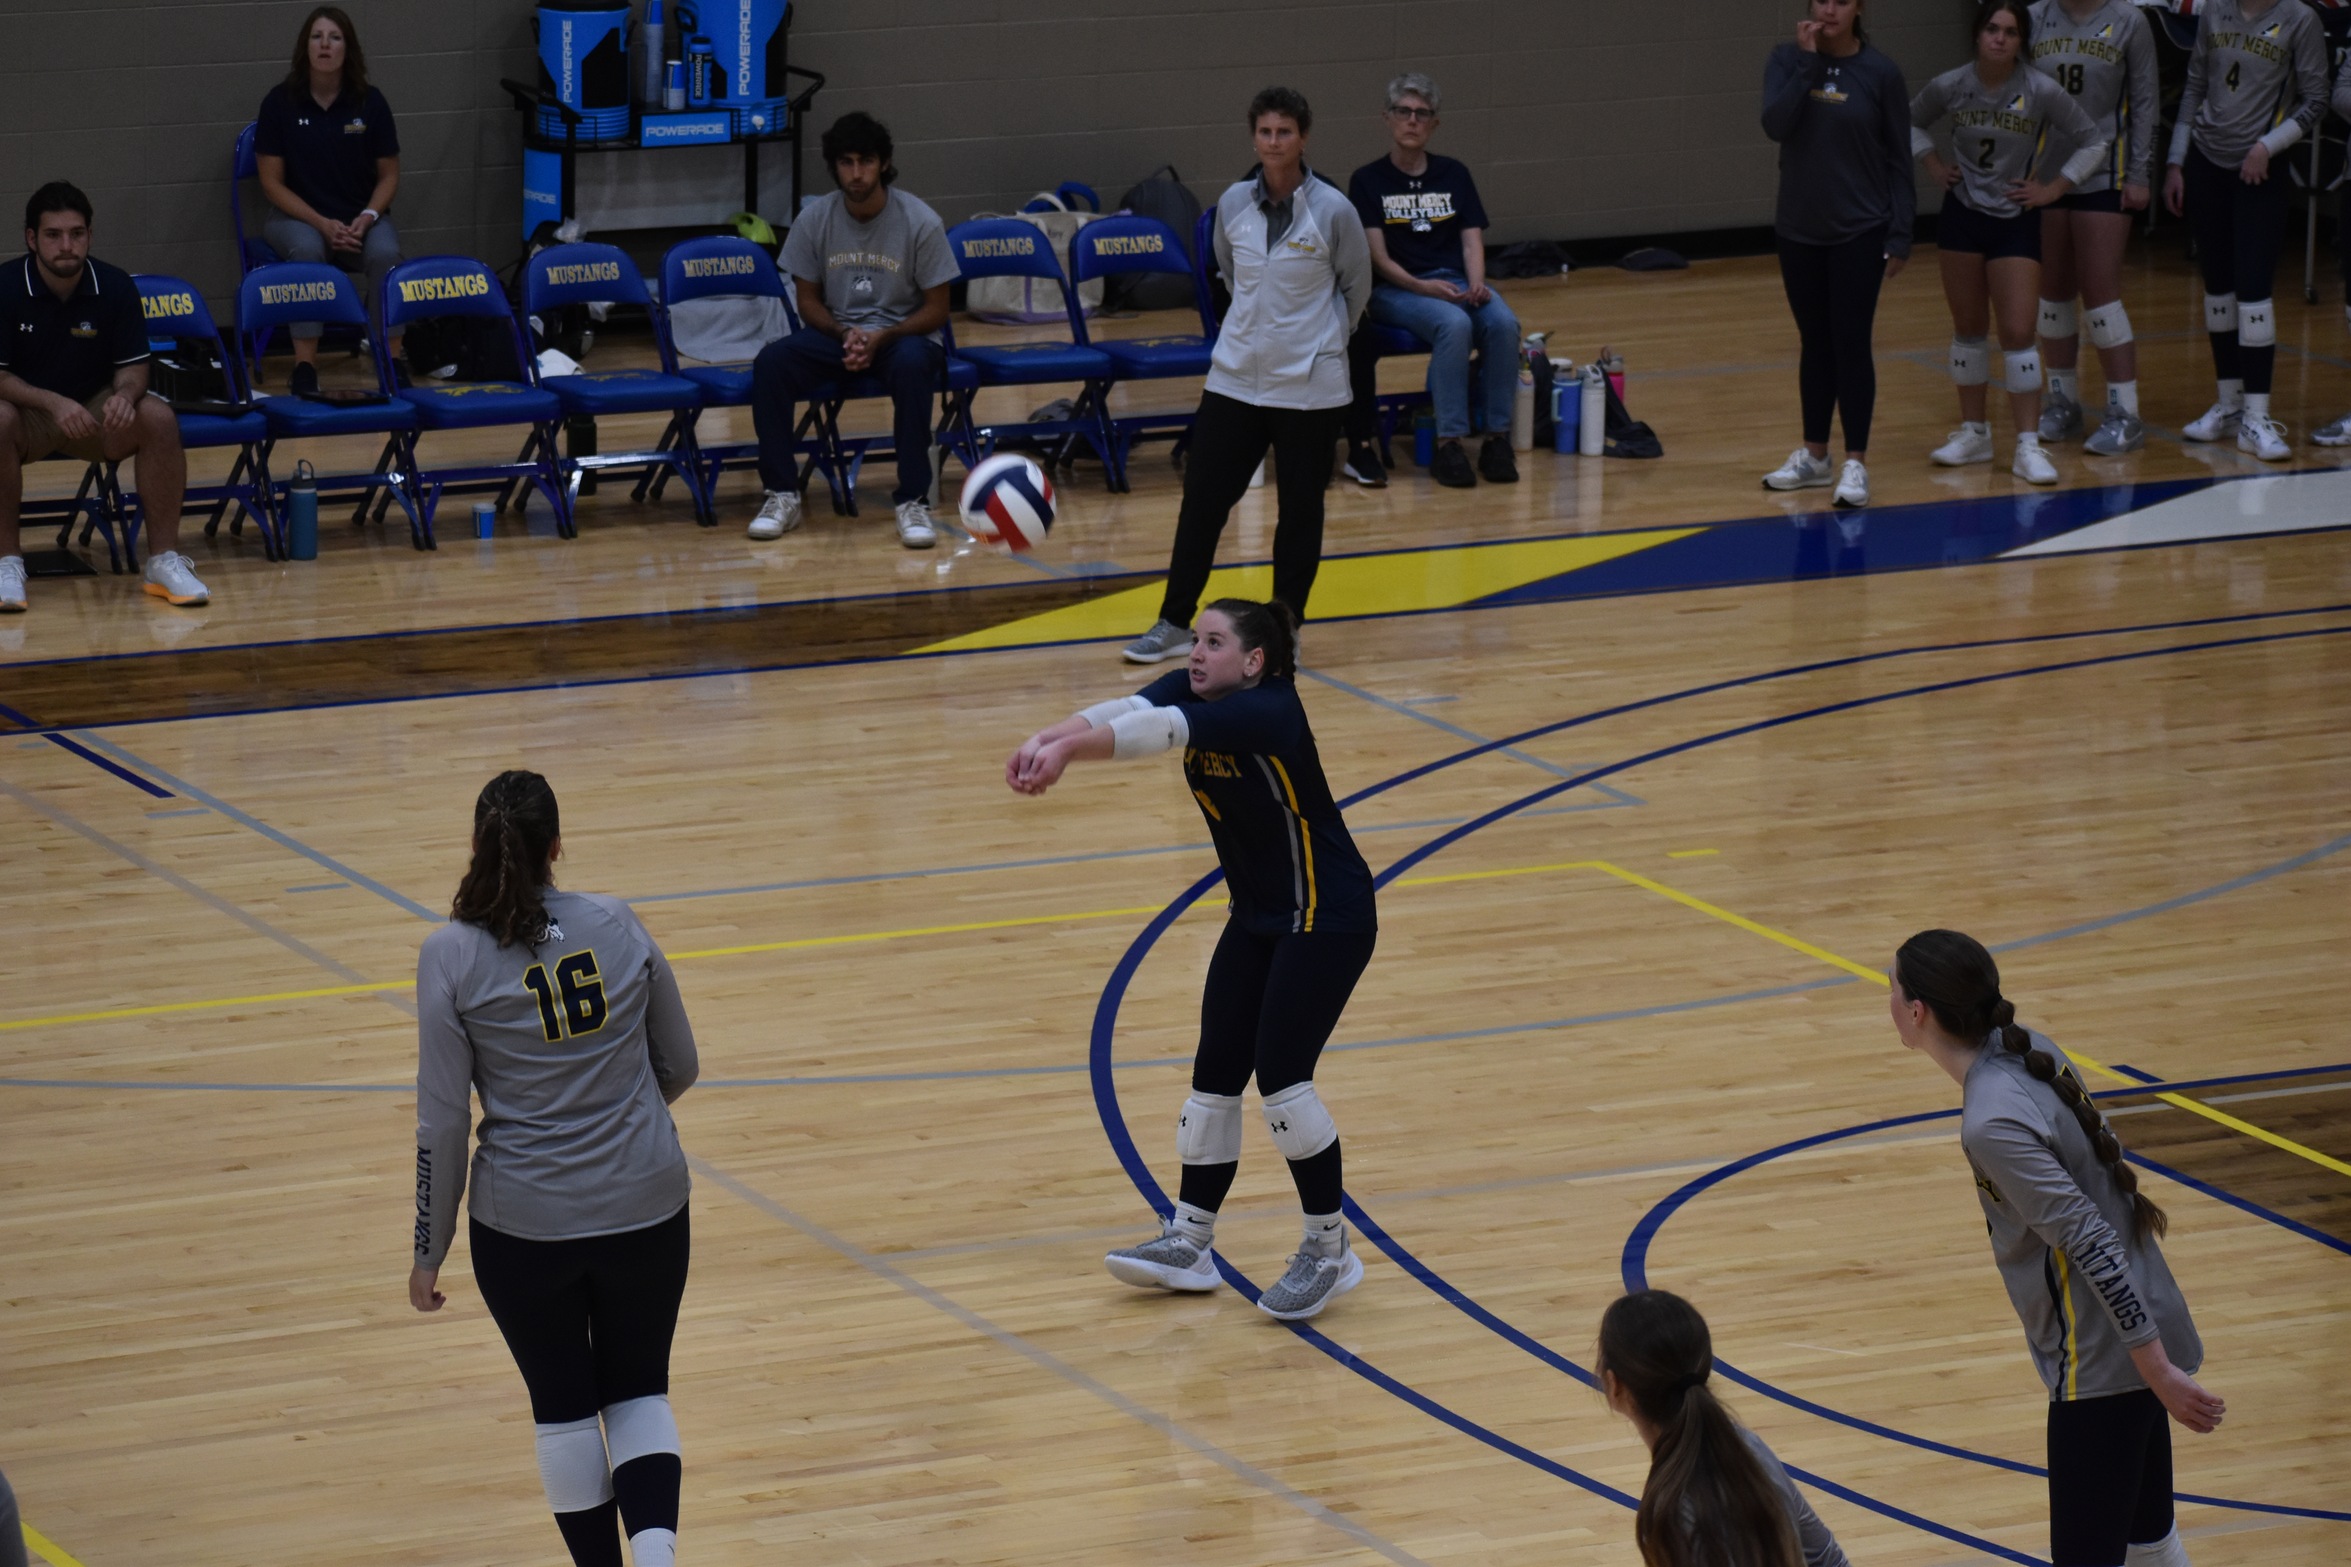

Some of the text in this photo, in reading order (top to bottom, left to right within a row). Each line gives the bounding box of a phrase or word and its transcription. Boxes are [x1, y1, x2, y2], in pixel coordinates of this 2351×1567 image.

[562, 20, 573, 103] POWERADE
[2076, 38, 2123, 65] MERCY
[2242, 34, 2289, 65] MERCY
[694, 53, 703, 98] POWERADE
[2056, 63, 2084, 96] 18
[2225, 60, 2240, 93] 4
[645, 124, 725, 137] POWERADE
[1992, 111, 2038, 135] MERCY
[1978, 138, 1995, 170] 2
[1381, 192, 1453, 210] MOUNT MERCY
[1383, 206, 1457, 219] VOLLEYBALL
[961, 237, 1035, 258] MUSTANGS
[1092, 235, 1164, 256] MUSTANGS
[546, 262, 620, 285] MUSTANGS
[682, 256, 755, 278] MUSTANGS
[828, 252, 865, 268] MOUNT
[867, 252, 901, 273] MERCY
[259, 281, 336, 304] MUSTANGS
[399, 274, 489, 302] MUSTANGS
[140, 293, 195, 319] TANGS
[522, 949, 608, 1043] 16
